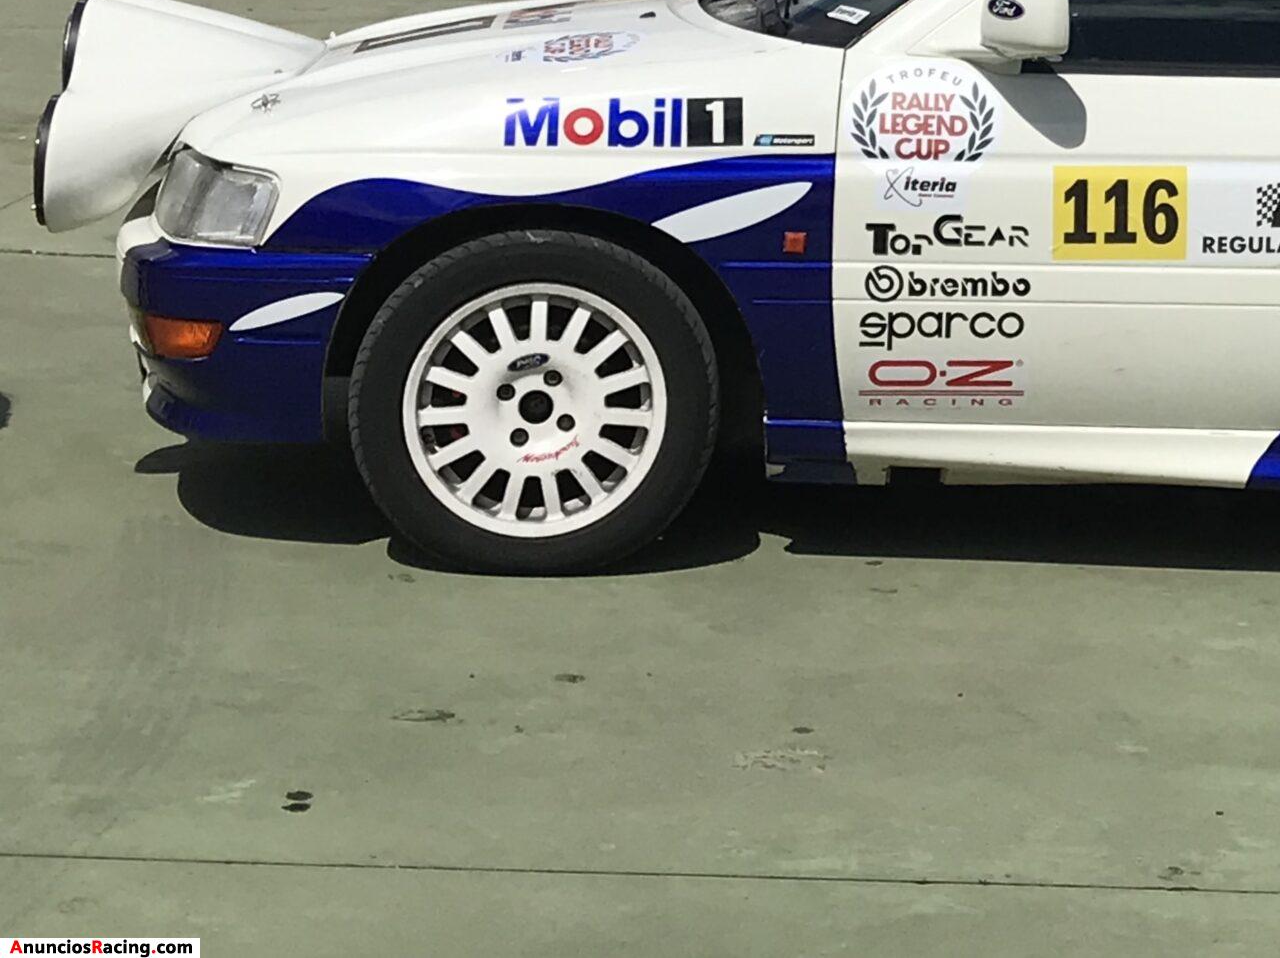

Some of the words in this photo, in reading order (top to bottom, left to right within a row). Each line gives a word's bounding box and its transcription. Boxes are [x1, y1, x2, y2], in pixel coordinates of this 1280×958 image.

[886, 67, 963, 87] TROFEU
[891, 92, 956, 112] RALLY
[504, 97, 682, 147] Mobil
[879, 113, 968, 136] LEGEND
[894, 138, 950, 161] CUP
[1063, 179, 1179, 244] 116
[908, 271, 1031, 297] brembo
[859, 312, 1025, 351] sparco
